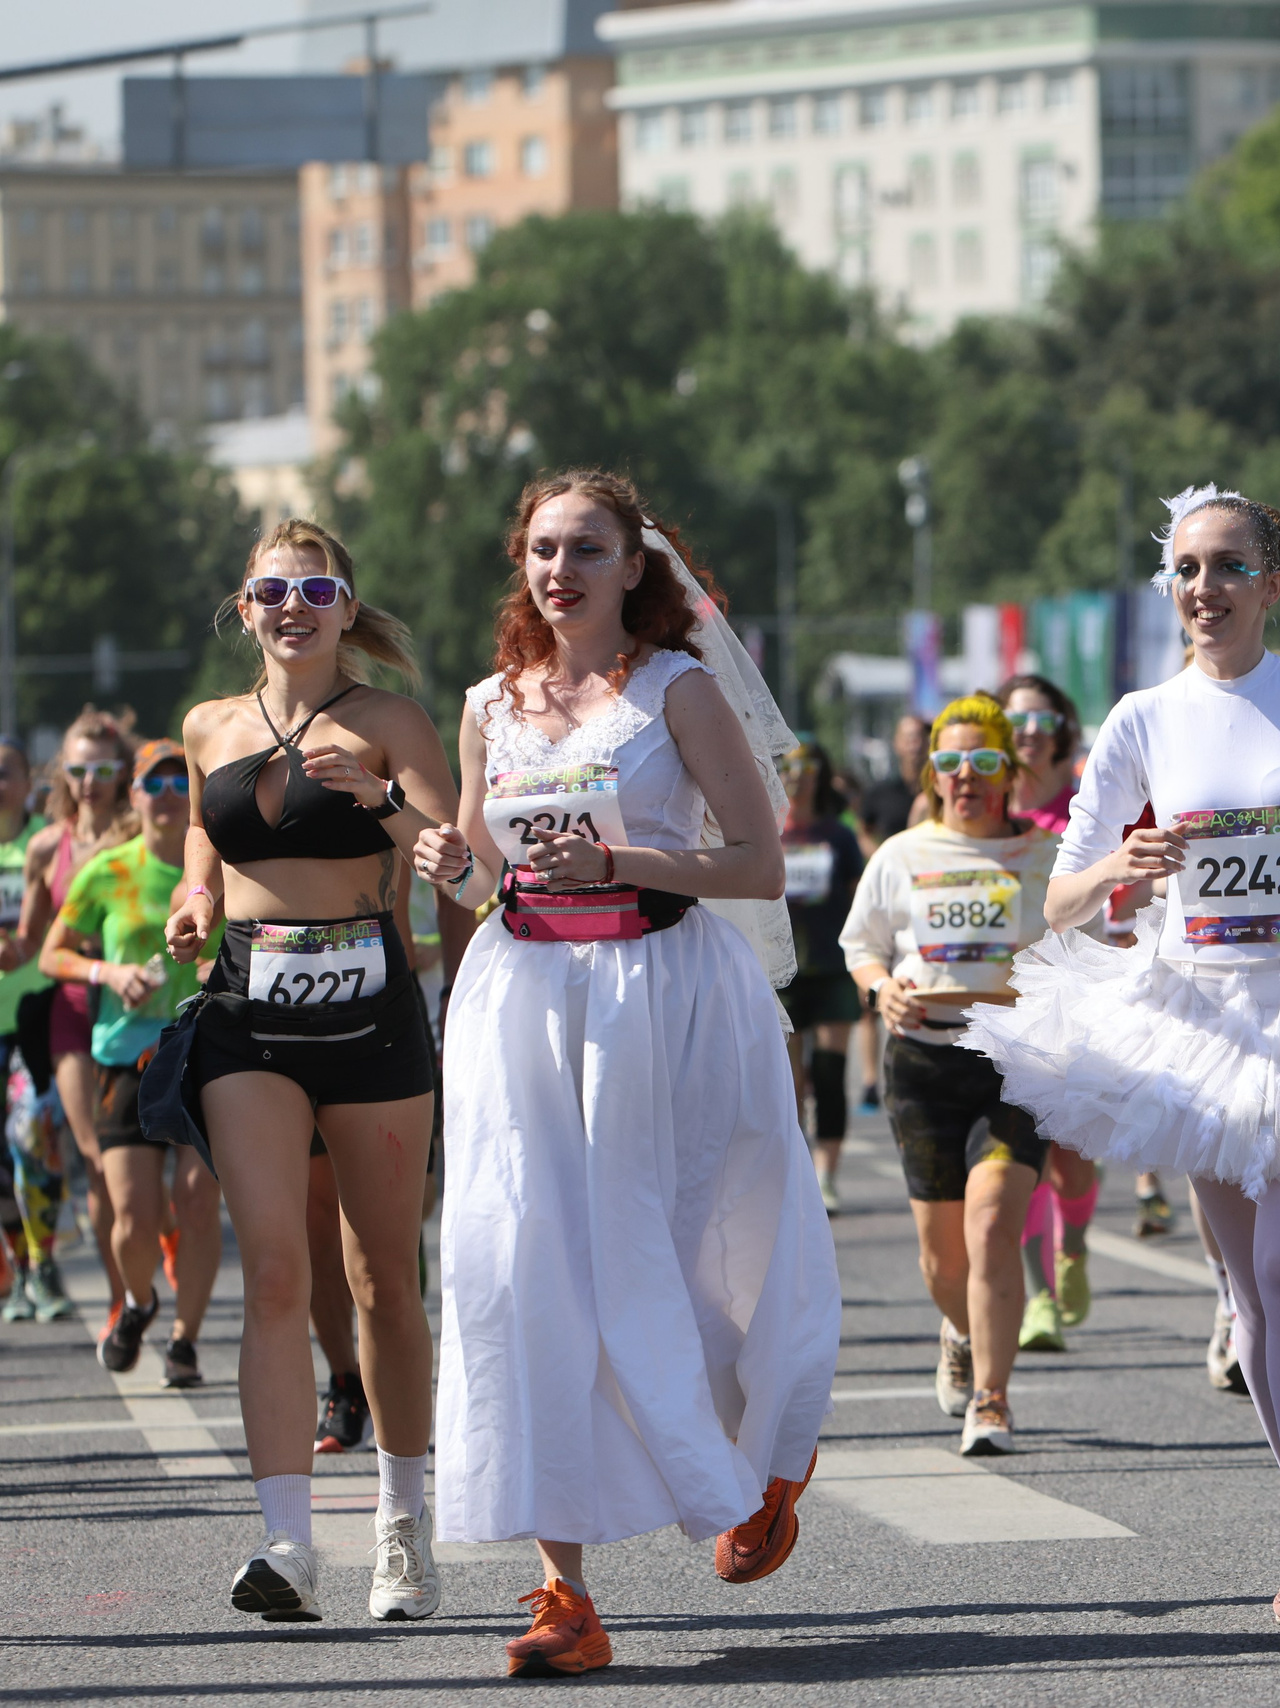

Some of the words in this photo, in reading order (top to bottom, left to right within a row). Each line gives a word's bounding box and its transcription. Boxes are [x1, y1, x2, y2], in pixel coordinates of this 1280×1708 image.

[497, 787, 550, 797] БЕГ
[556, 781, 614, 794] 2026
[928, 901, 1006, 929] 5882
[263, 922, 370, 944] КРАСОЧНЫЙ
[324, 938, 380, 952] 2026
[268, 967, 366, 1005] 6227
